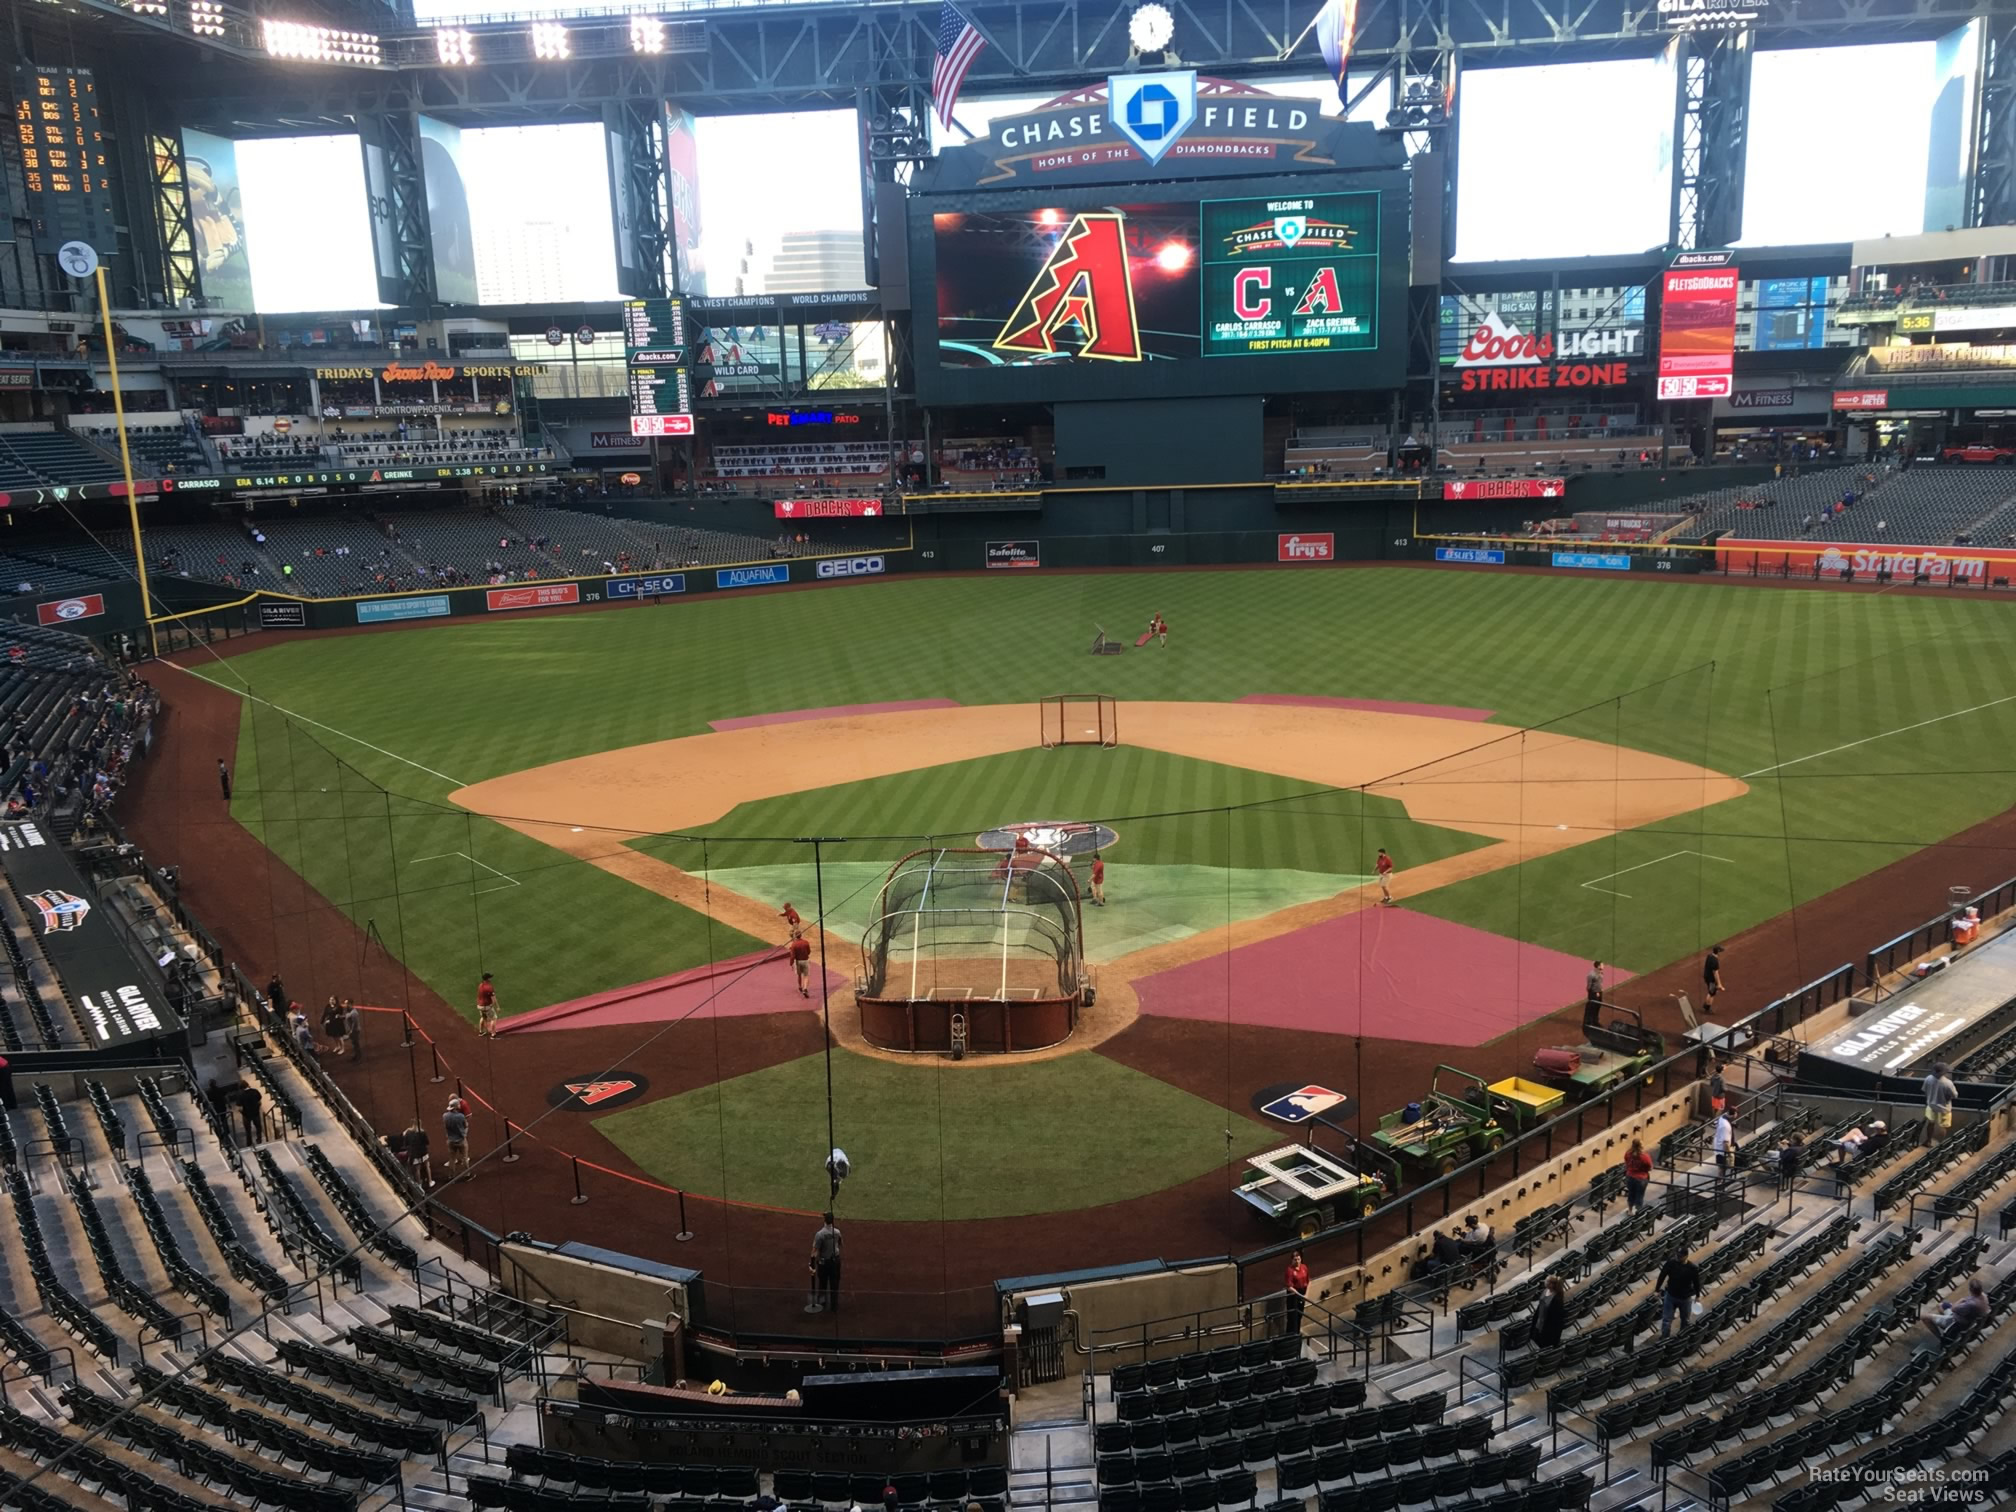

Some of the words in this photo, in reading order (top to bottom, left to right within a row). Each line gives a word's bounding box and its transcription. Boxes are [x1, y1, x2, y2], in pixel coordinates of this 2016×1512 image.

[1658, 0, 1705, 12] GILA
[1678, 21, 1748, 32] CASINOS
[38, 78, 50, 86] TB
[69, 79, 75, 88] 2
[40, 88, 56, 96] DET
[70, 88, 77, 98] 2
[72, 103, 79, 112] 2
[91, 108, 97, 117] 7
[17, 111, 31, 120] 37
[43, 112, 60, 120] BOS
[74, 113, 80, 121] 2
[20, 125, 33, 134] 52
[46, 126, 62, 134] STL
[94, 132, 101, 141] 5
[1002, 114, 1100, 148] CHASE
[1204, 107, 1307, 130] FIELD
[21, 135, 35, 144] 52
[77, 136, 84, 145] 0
[24, 148, 37, 158] 30
[98, 156, 104, 165] 2
[1038, 155, 1073, 167] HOME
[1083, 153, 1096, 161] OF
[1107, 149, 1129, 158] THE
[1176, 145, 1269, 154] DIAMONDBACKS
[25, 158, 38, 168] 38
[81, 160, 87, 169] 3
[27, 173, 40, 182] 35
[82, 174, 89, 182] 0
[101, 179, 108, 188] 2
[28, 182, 42, 192] 43
[84, 183, 90, 192] 0
[1267, 201, 1302, 211] WELCOME
[1304, 200, 1314, 209] TO
[1236, 231, 1273, 243] CHASE
[1308, 228, 1344, 238] FIELD
[1680, 255, 1724, 264] dbacks.com
[792, 296, 818, 304] WORLD
[821, 293, 868, 303] CHAMPIONS
[1234, 266, 1271, 321] C
[1285, 288, 1294, 296] VS
[704, 299, 726, 307] WEST
[728, 297, 774, 306] CHAMPIONS
[1502, 303, 1517, 312] BIG
[1216, 323, 1242, 332] CARLOS
[1244, 321, 1281, 330] CARRASCO
[1306, 318, 1325, 327] ZACK
[1326, 317, 1356, 326] GREINKE
[1903, 316, 1930, 329] 5:36
[1249, 340, 1269, 349] FIRST
[1271, 339, 1292, 348] PITCH
[1294, 339, 1302, 347] AT
[1304, 338, 1330, 347] 6:40PM
[1463, 325, 1554, 361] Coors
[1558, 330, 1640, 356] LIGHT
[316, 368, 373, 379] FRIDAY'S
[463, 366, 510, 378] SPORTS
[515, 365, 548, 377] GRILL
[714, 367, 735, 375] WILD
[737, 366, 759, 374] CARD
[10, 375, 31, 384] SEATS
[1461, 368, 1549, 391] STRIKE
[1556, 363, 1628, 386] ZONE
[1664, 379, 1680, 393] 50
[1682, 378, 1696, 392] 50
[1756, 394, 1792, 405] FITNESS
[374, 404, 464, 415] FRONTROWPHOENIX.com
[835, 415, 859, 423] PATIO
[610, 437, 641, 446] FITNESS
[384, 470, 413, 479] GREINKE
[178, 479, 220, 489] CARRASCO
[236, 478, 251, 487] ERA
[256, 477, 274, 485] 6.14
[278, 475, 288, 484] PC
[1607, 519, 1619, 528] RAM
[1620, 519, 1641, 528] TRUCKS
[1151, 544, 1165, 553] 407
[1285, 536, 1328, 558] fry's
[818, 557, 883, 576] GEICO
[1852, 549, 1915, 573] State
[1920, 552, 1984, 577] Farm
[730, 567, 775, 584] AQUAFINA
[116, 985, 145, 1006] GILA
[126, 1002, 160, 1031] RIVER
[1832, 1032, 1885, 1056] GILA
[1867, 1005, 1928, 1035] RIVER
[1861, 1040, 1899, 1063] HOTELS
[1906, 1012, 1945, 1036] CASINOS
